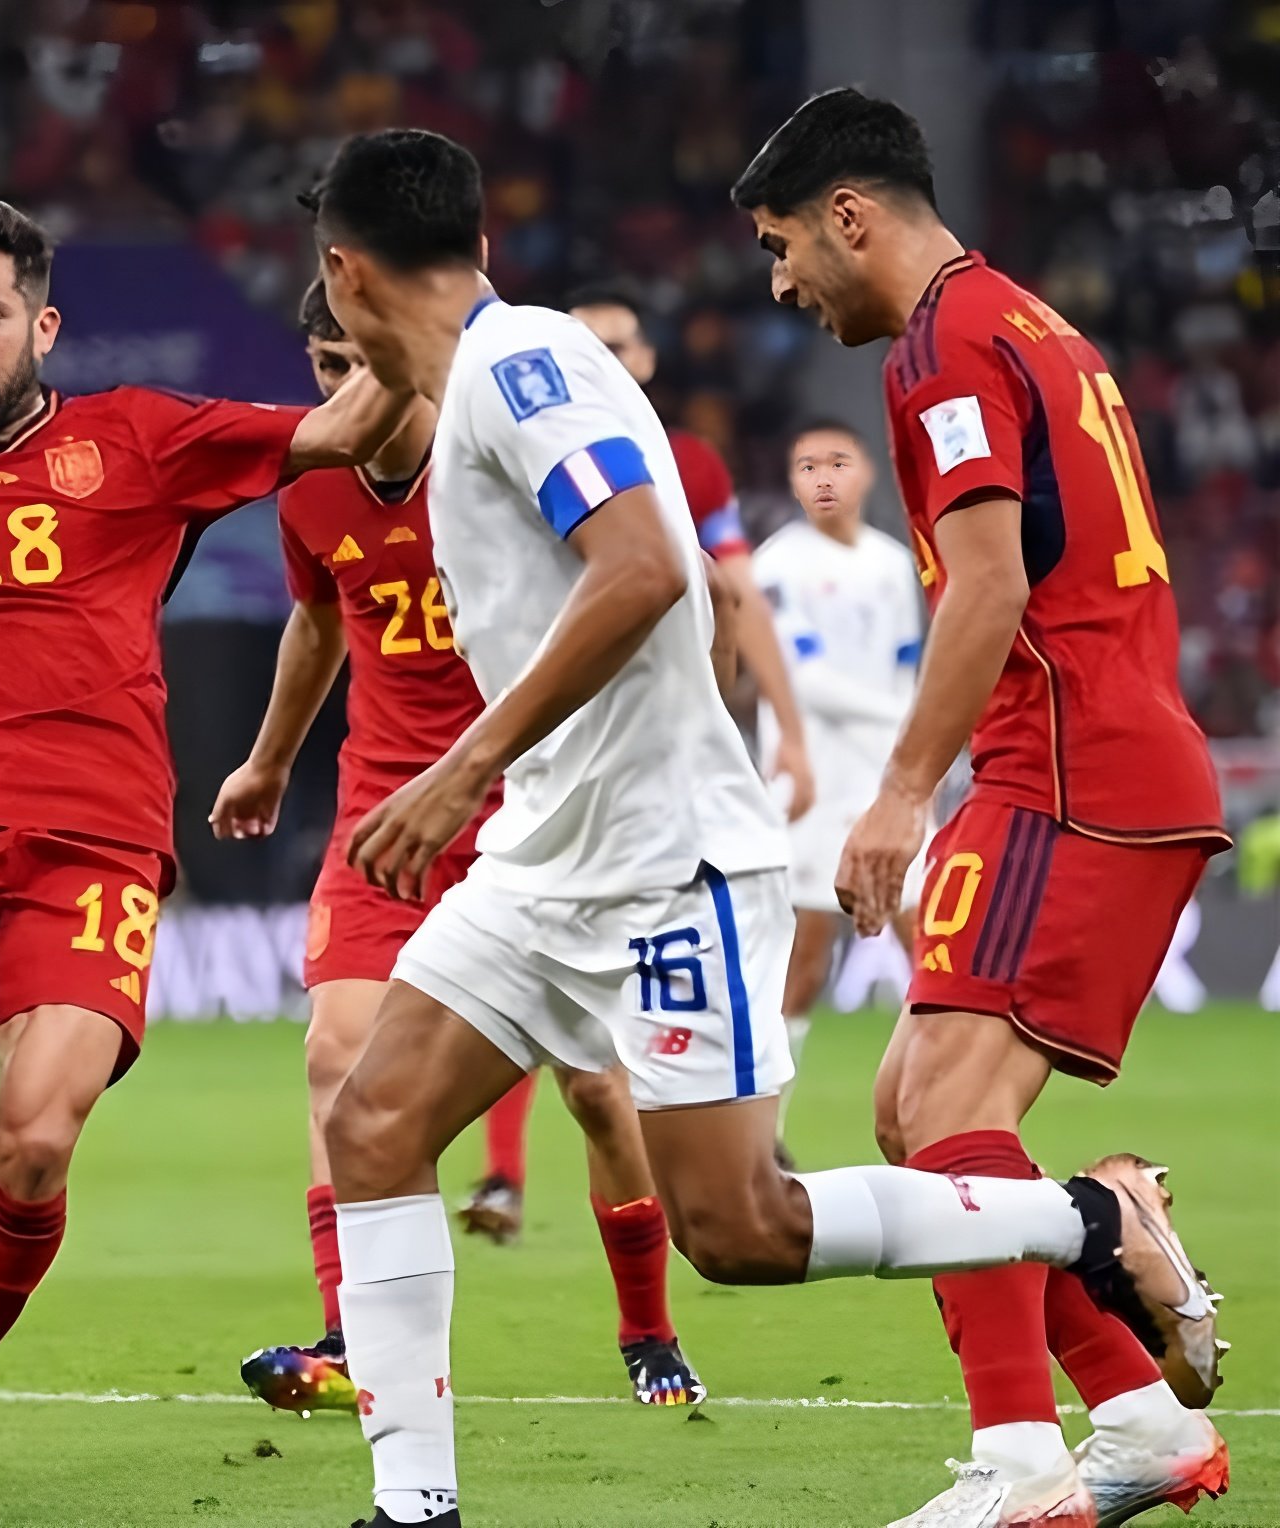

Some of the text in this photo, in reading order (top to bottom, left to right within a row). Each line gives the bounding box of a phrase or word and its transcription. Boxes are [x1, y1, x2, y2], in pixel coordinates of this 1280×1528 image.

[369, 577, 454, 656] 26
[70, 883, 159, 970] 18
[923, 852, 984, 937] 0
[628, 926, 708, 1012] 16
